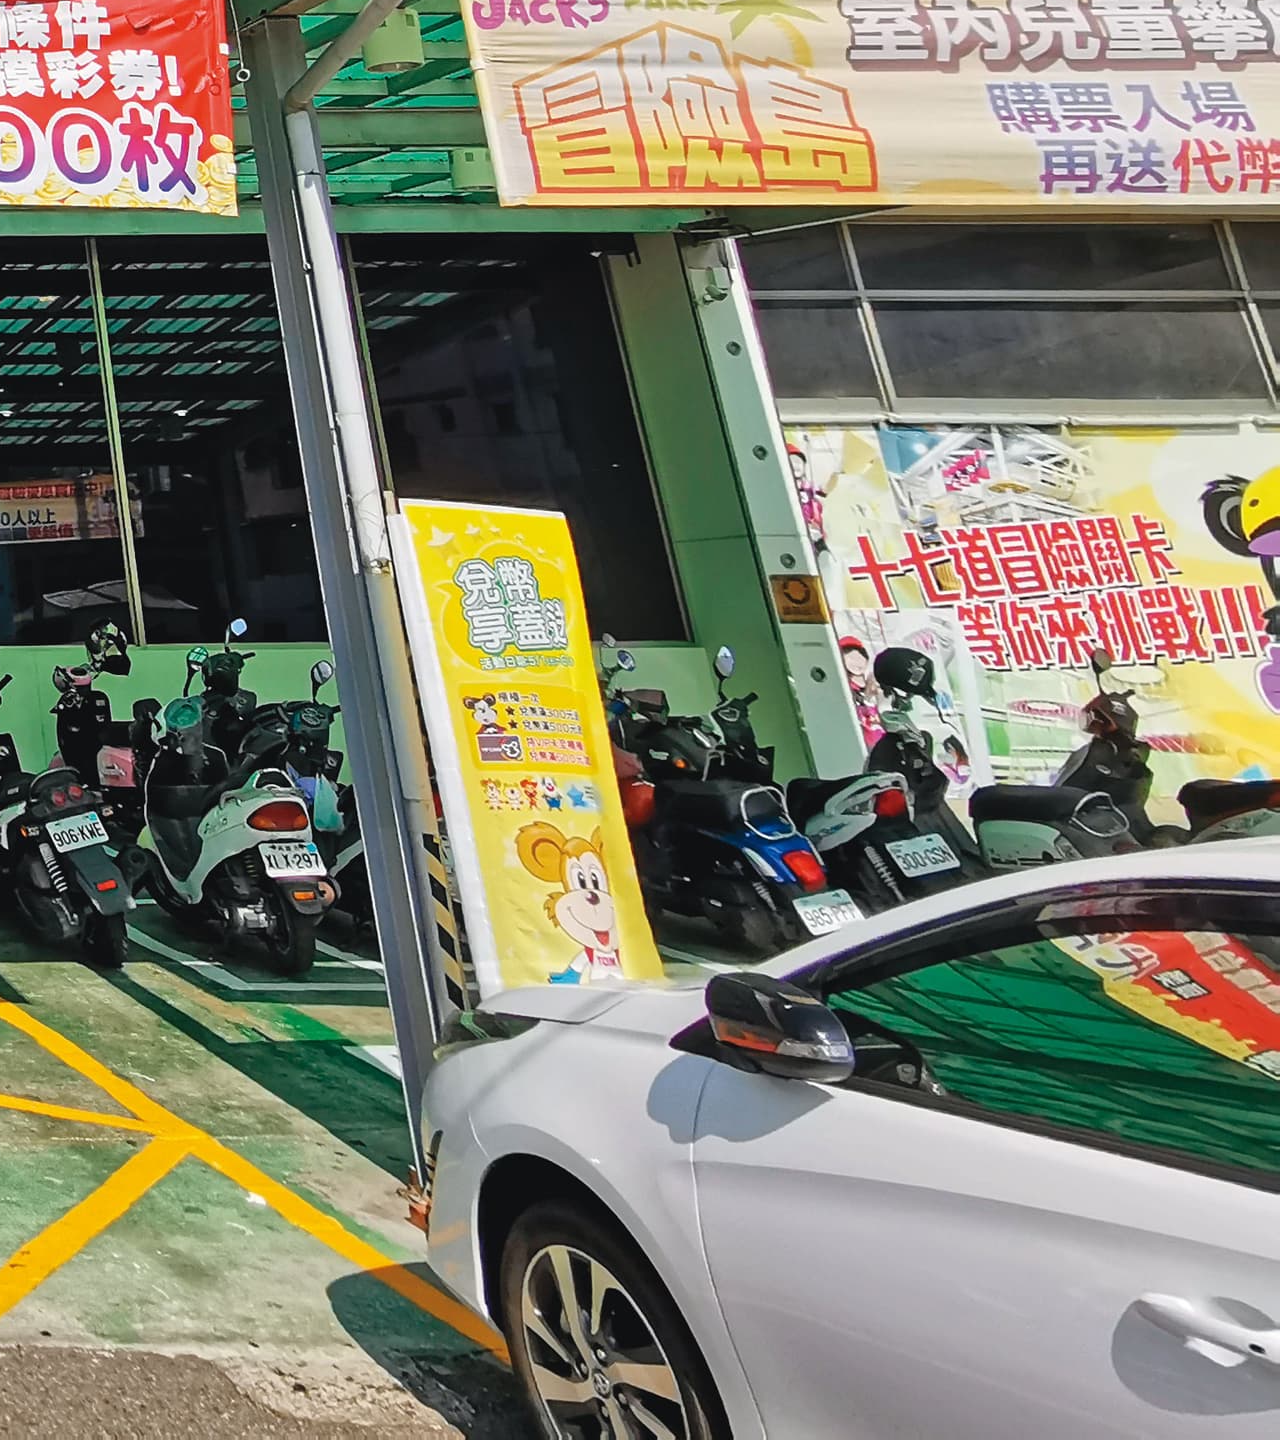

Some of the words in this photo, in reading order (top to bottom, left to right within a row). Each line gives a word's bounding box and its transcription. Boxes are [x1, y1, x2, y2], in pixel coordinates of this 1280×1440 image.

[986, 81, 1256, 133] 購票入場
[849, 514, 1179, 611] 十七道冒險關卡
